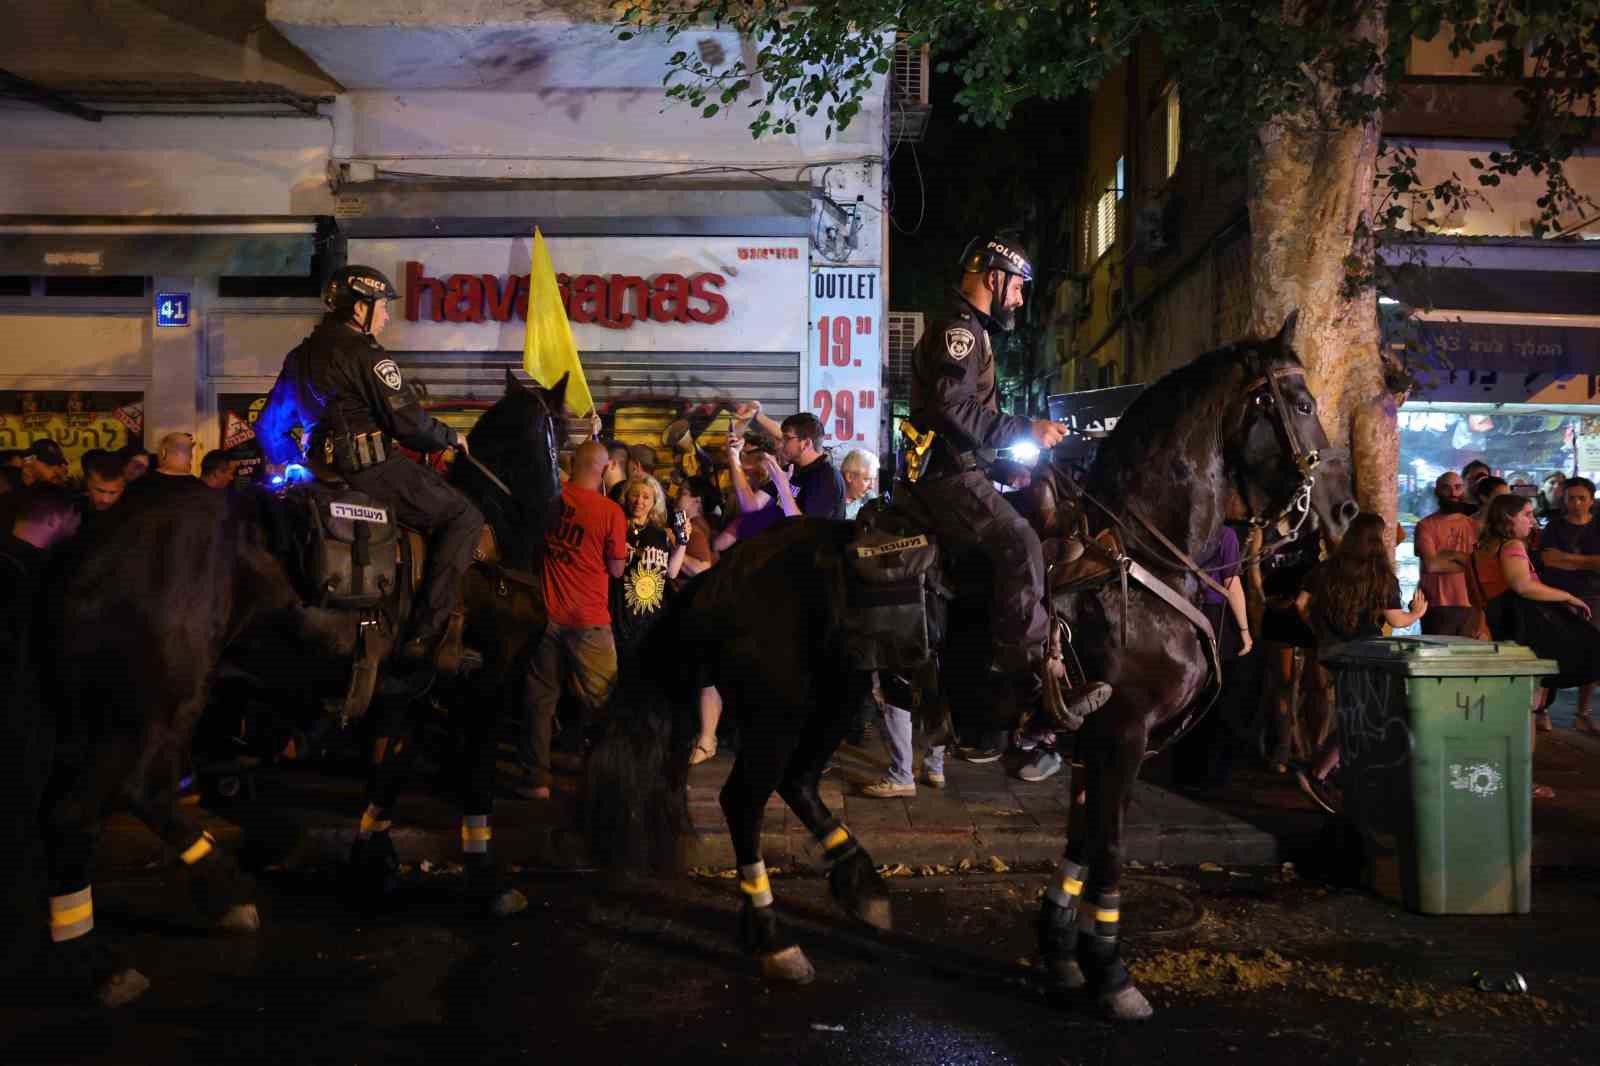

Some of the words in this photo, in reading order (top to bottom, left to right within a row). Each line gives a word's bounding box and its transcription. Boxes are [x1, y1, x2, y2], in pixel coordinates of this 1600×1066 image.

[987, 241, 1025, 269] POLICE
[815, 273, 876, 299] OUTLET
[160, 300, 185, 319] 41
[335, 504, 384, 521] משטרה
[1455, 690, 1487, 723] 41
